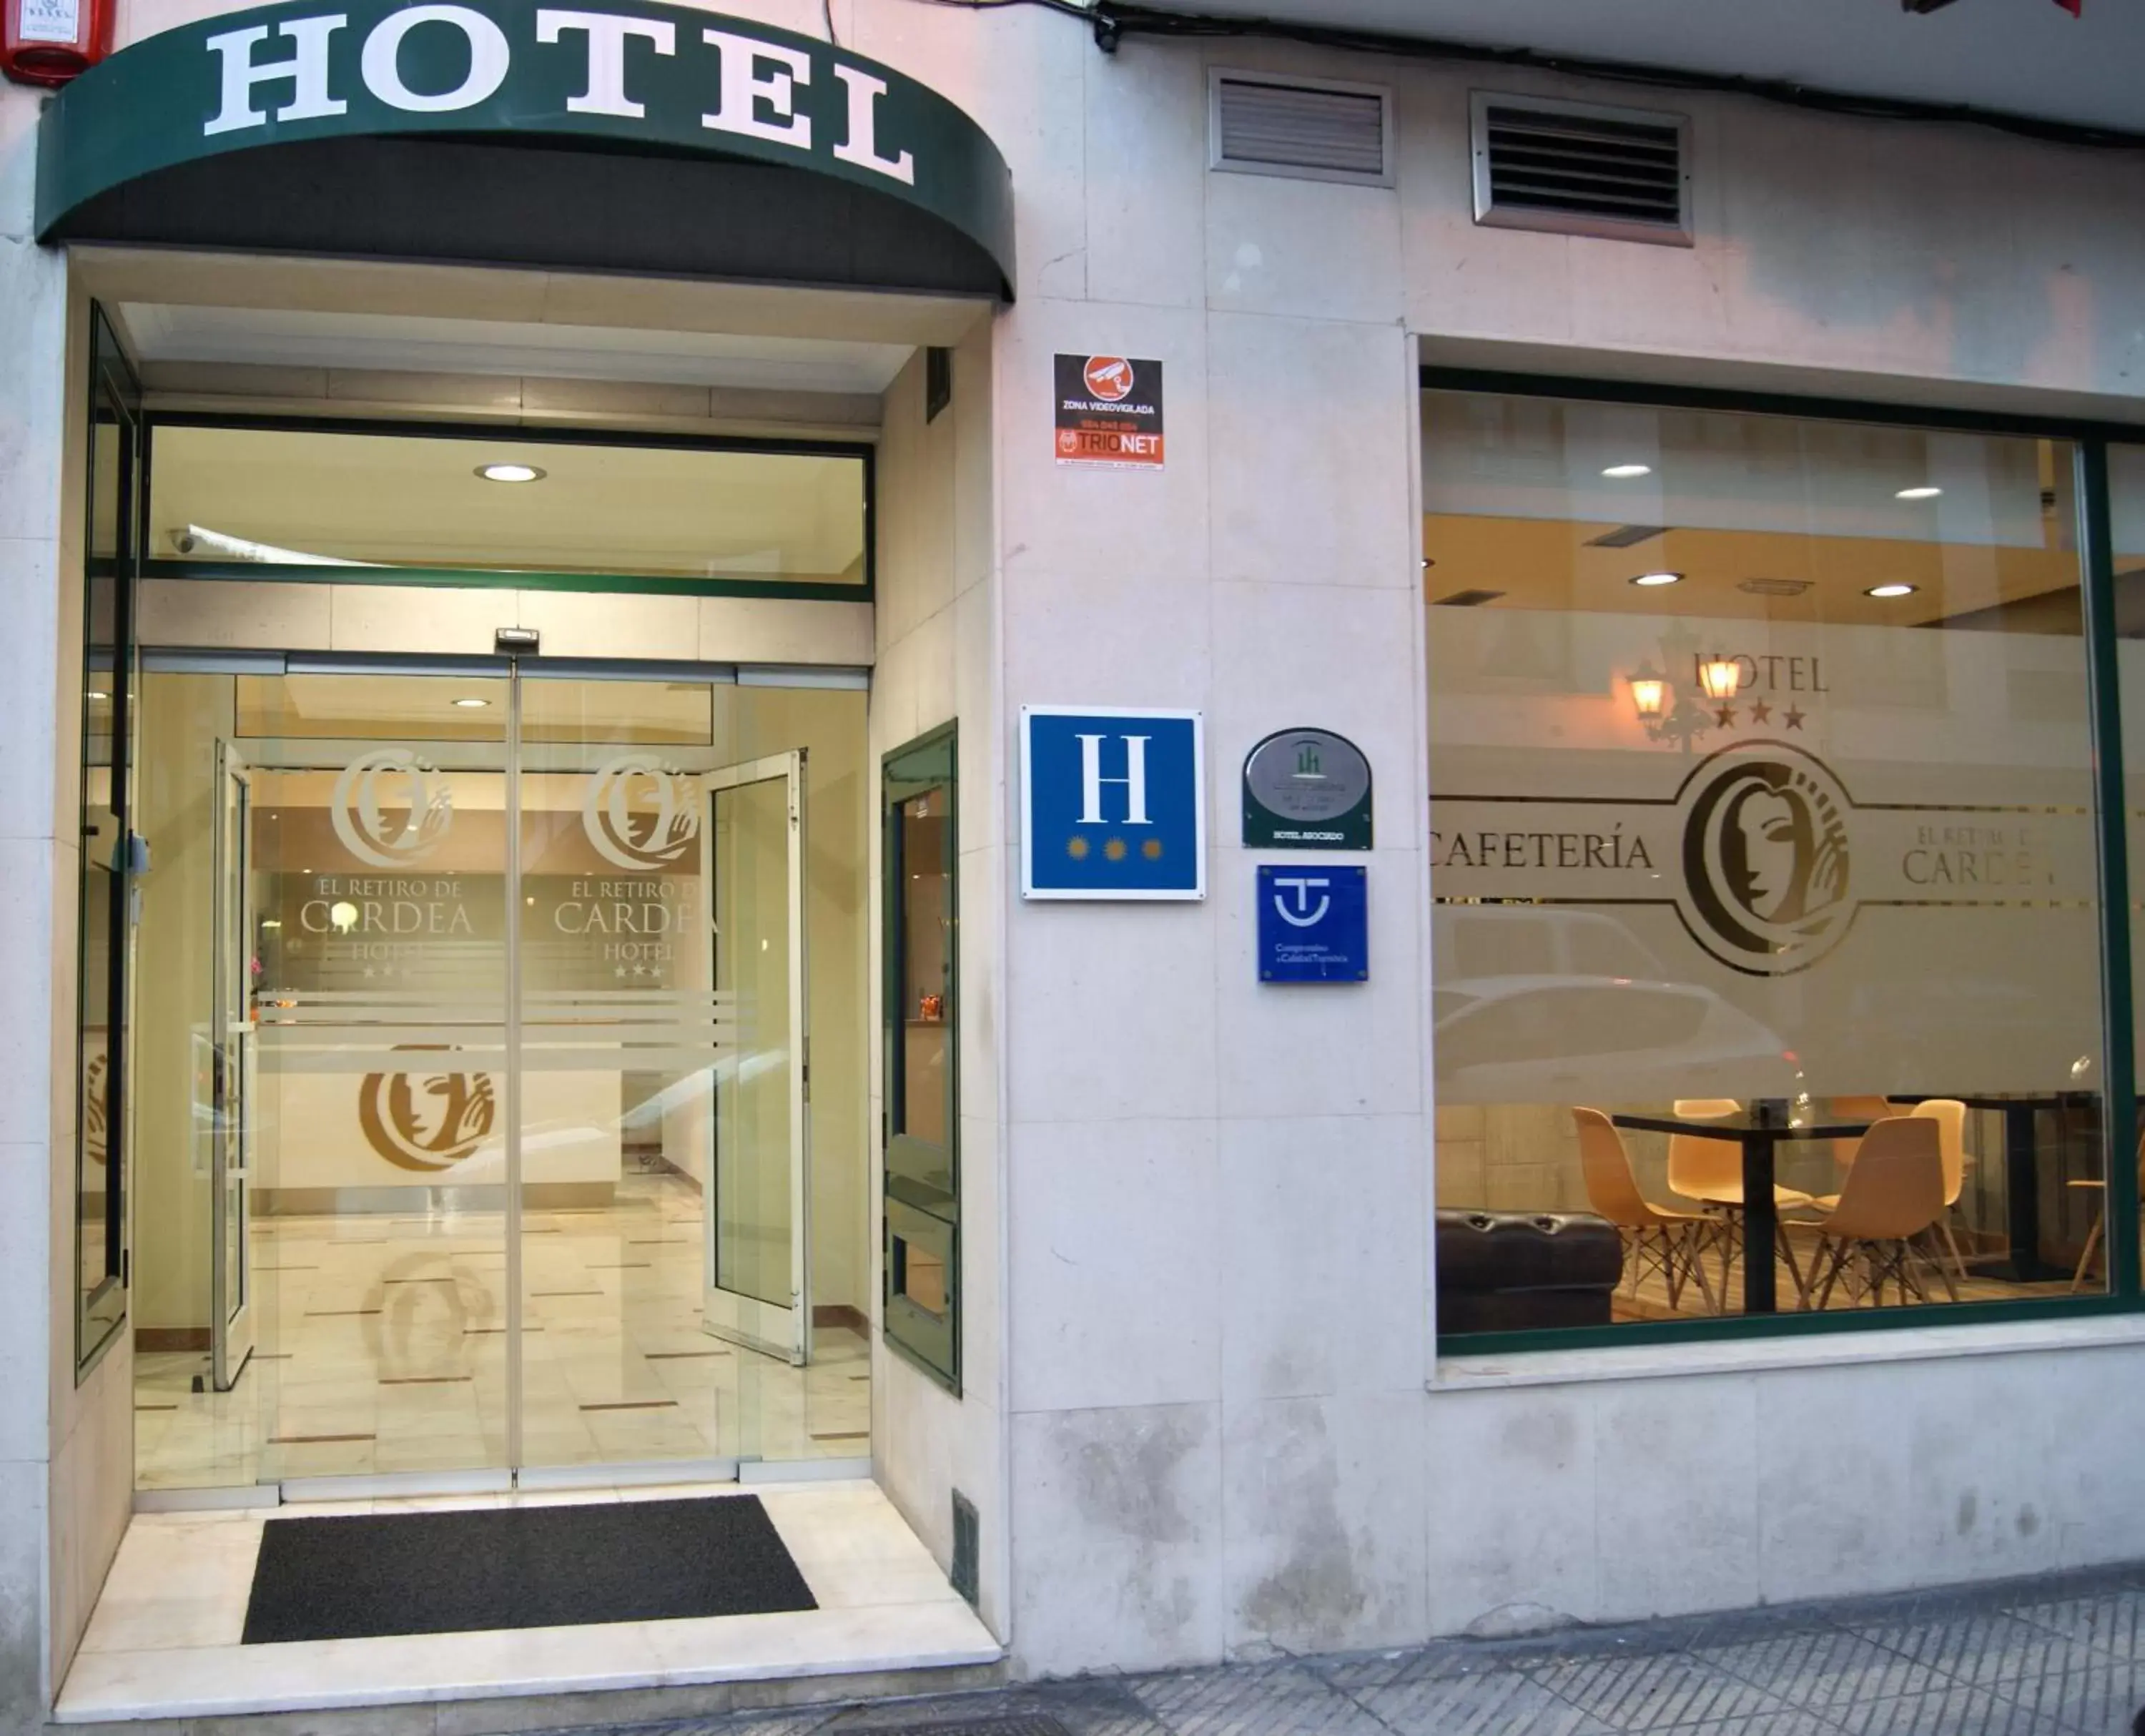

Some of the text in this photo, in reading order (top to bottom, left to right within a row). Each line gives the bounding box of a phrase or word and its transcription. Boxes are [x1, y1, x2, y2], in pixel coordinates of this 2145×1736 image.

[204, 4, 914, 185] HOTEL
[1063, 400, 1088, 411] ZONA
[1078, 432, 1158, 454] TRIONET
[1075, 735, 1153, 824] H
[1902, 848, 2056, 885] CARDE
[320, 879, 463, 898] EL RETIRO DE
[572, 881, 593, 897] EL
[600, 882, 674, 898] RETIRO
[300, 900, 475, 934] CRDEA
